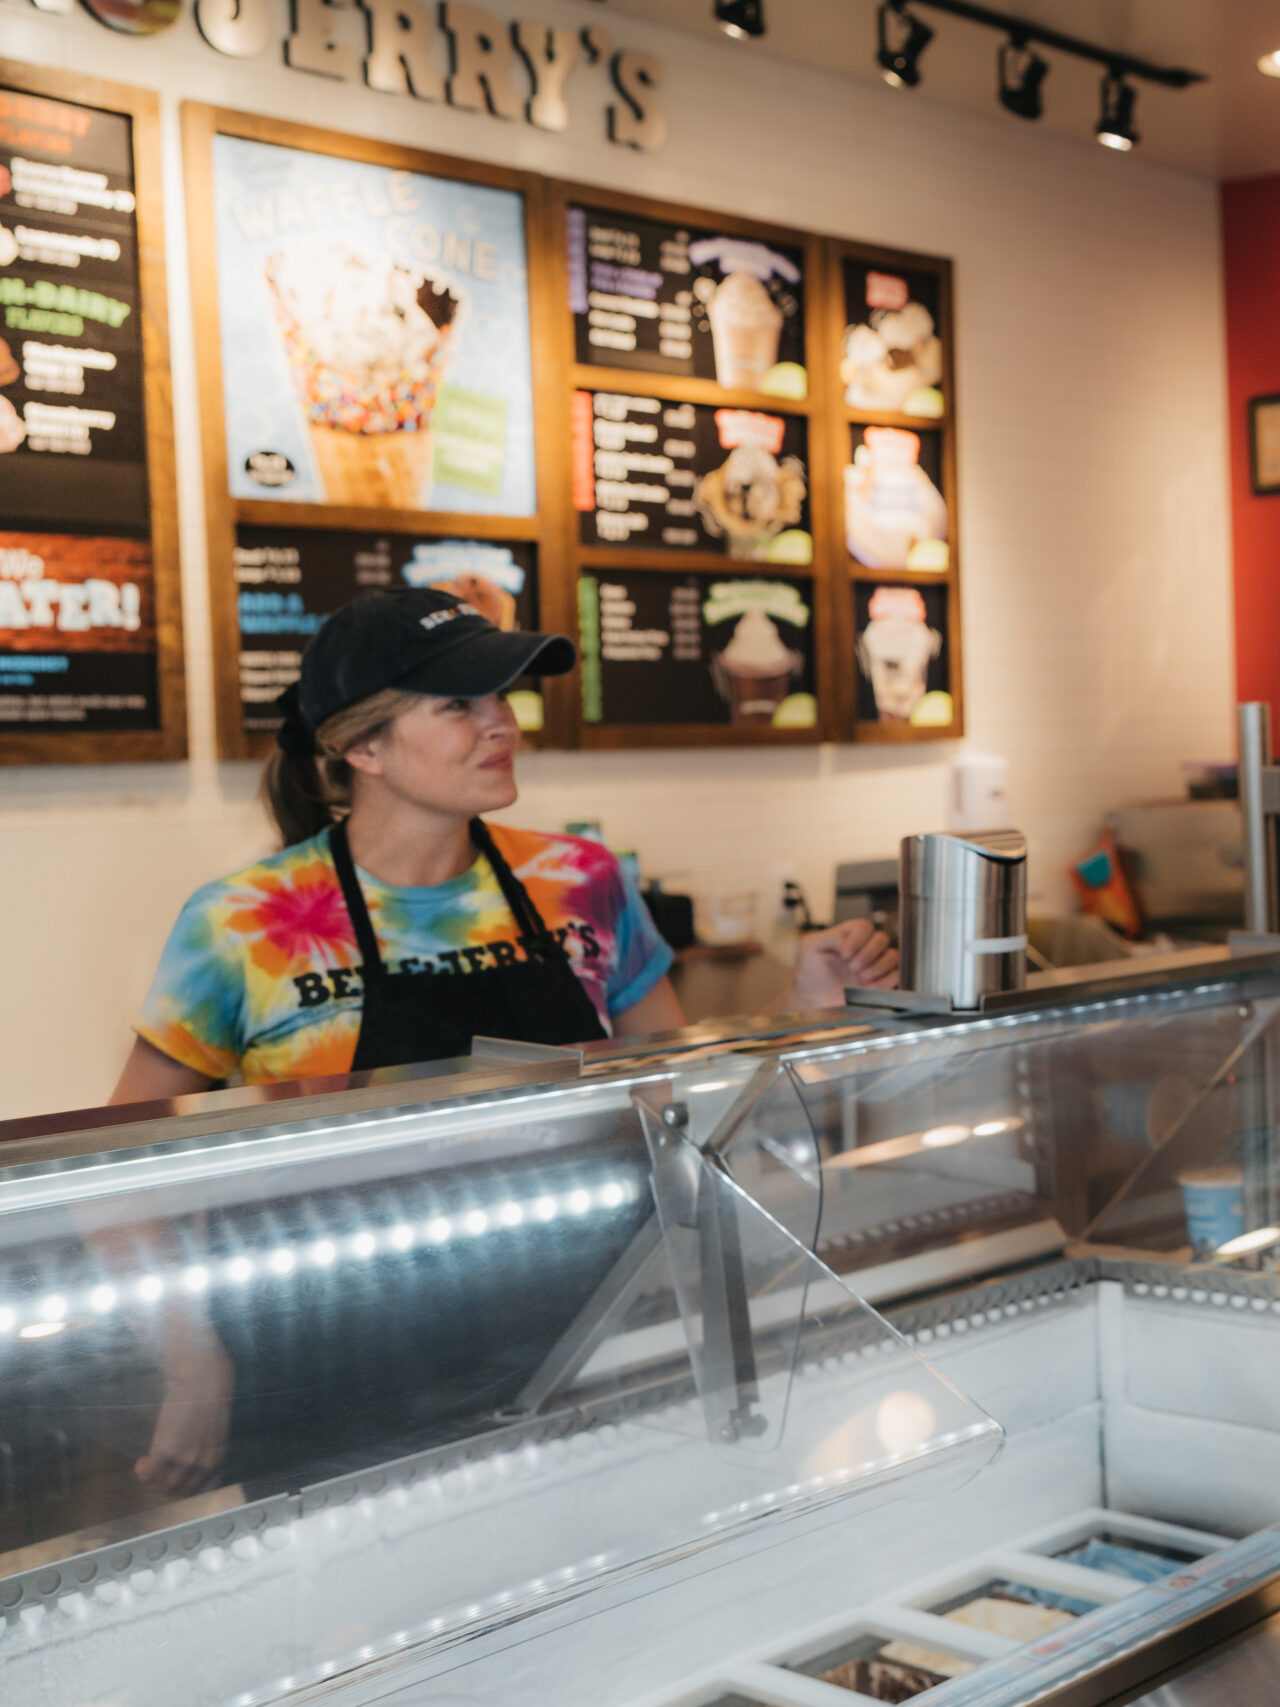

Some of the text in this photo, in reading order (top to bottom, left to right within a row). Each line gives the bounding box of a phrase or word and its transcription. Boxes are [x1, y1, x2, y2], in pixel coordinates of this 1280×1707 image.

[229, 168, 421, 241] WAFFLE
[380, 213, 500, 281] CONE
[293, 962, 388, 1008] BE
